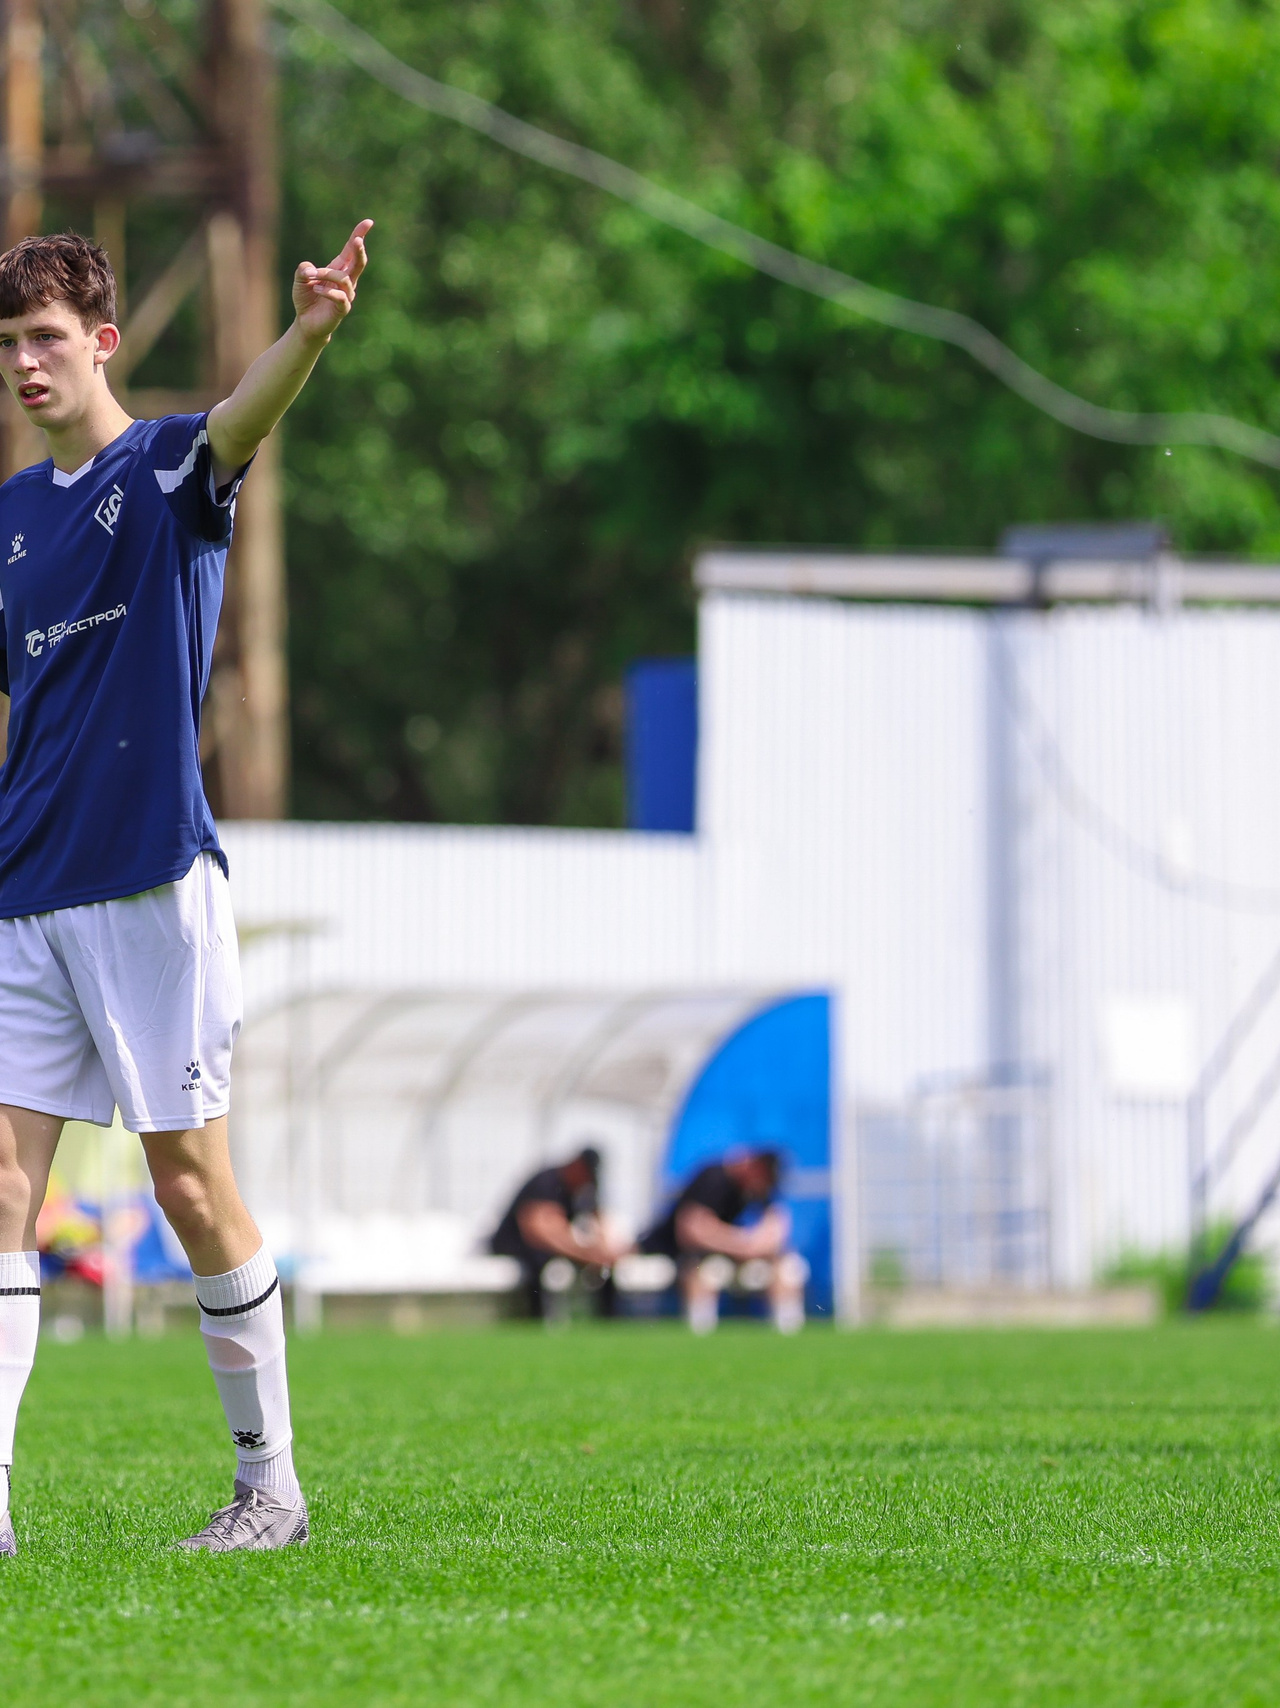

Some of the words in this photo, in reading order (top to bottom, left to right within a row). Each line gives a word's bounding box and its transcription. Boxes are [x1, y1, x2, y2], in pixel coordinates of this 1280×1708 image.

[7, 549, 26, 565] KELME
[48, 620, 67, 638] ДСК
[181, 1083, 200, 1091] KEL
